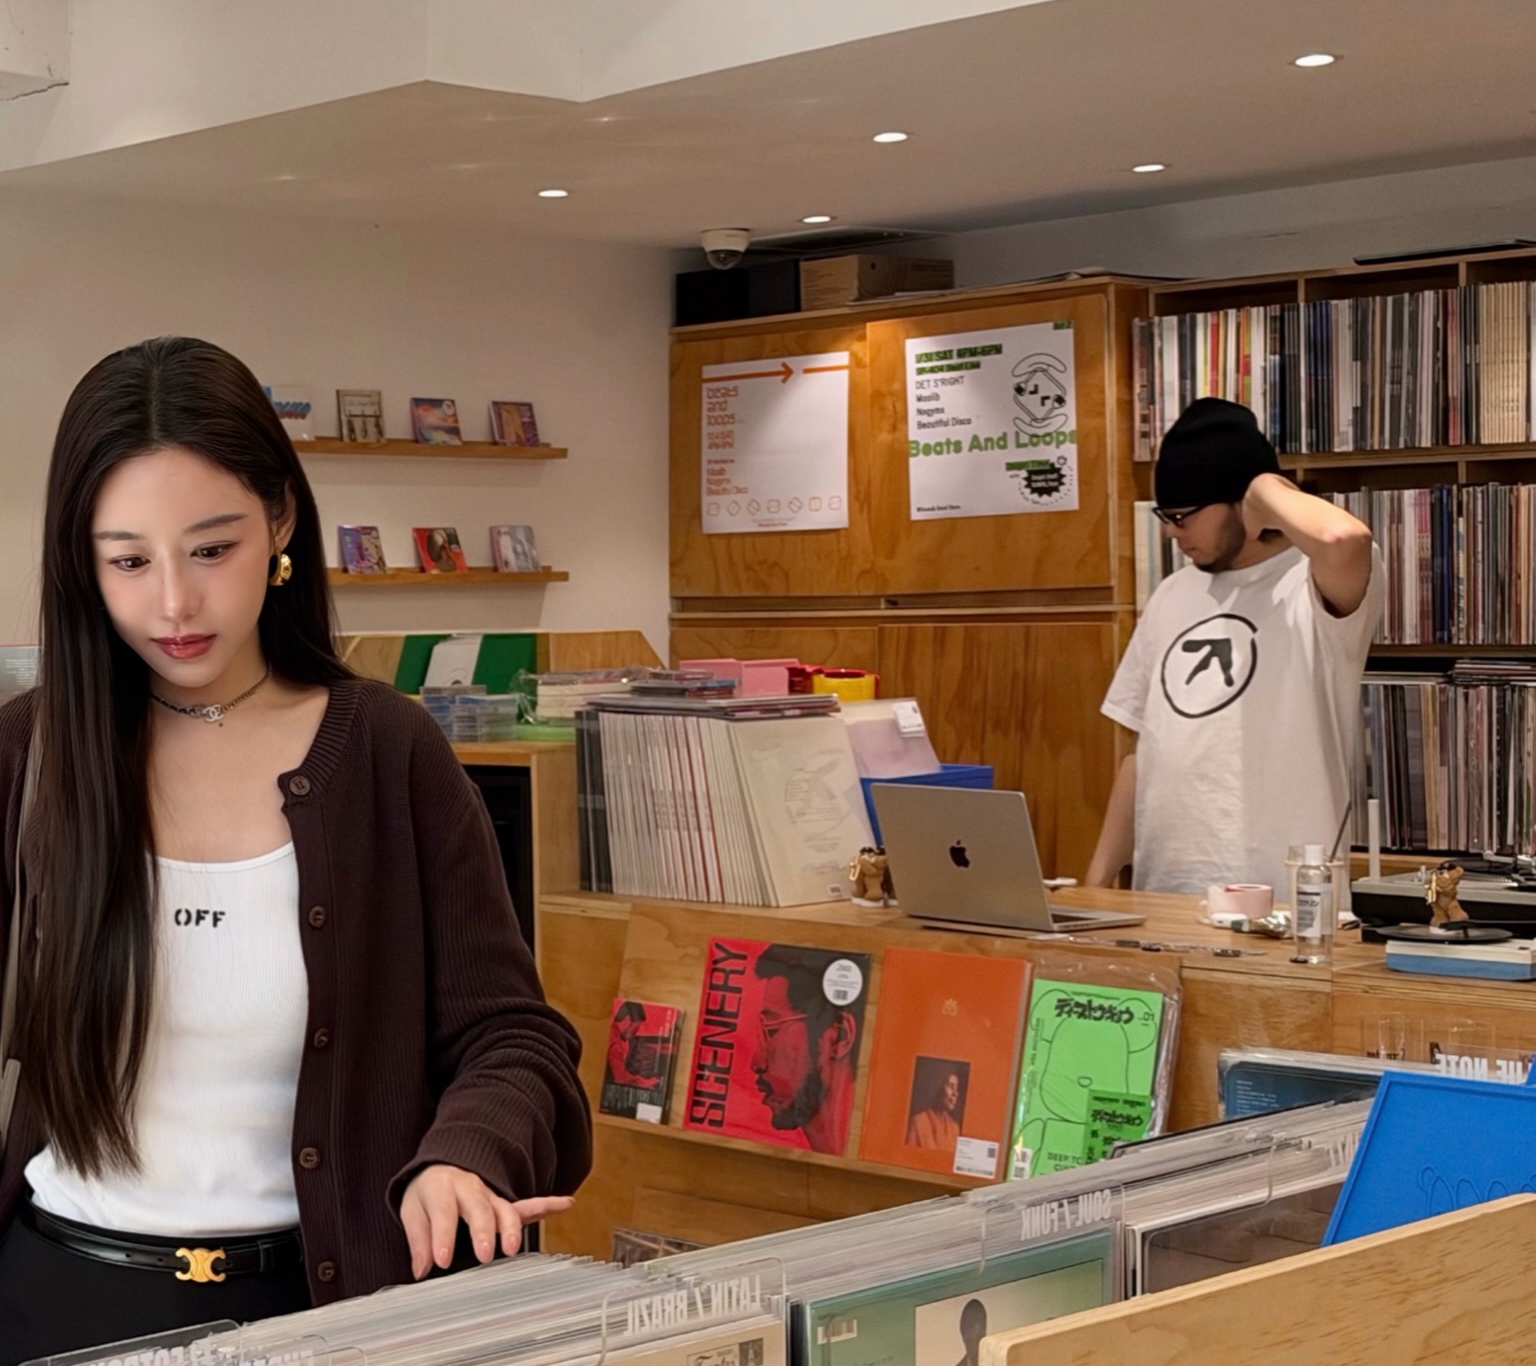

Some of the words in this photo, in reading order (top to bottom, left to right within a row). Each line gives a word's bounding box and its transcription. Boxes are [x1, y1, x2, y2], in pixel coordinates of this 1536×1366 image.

[917, 420, 949, 430] Beautiful
[951, 418, 972, 427] Disco
[909, 439, 962, 457] Beats
[968, 434, 1008, 453] And
[1015, 430, 1077, 449] Loops
[175, 908, 226, 928] OFF
[689, 943, 748, 1128] SCENERY
